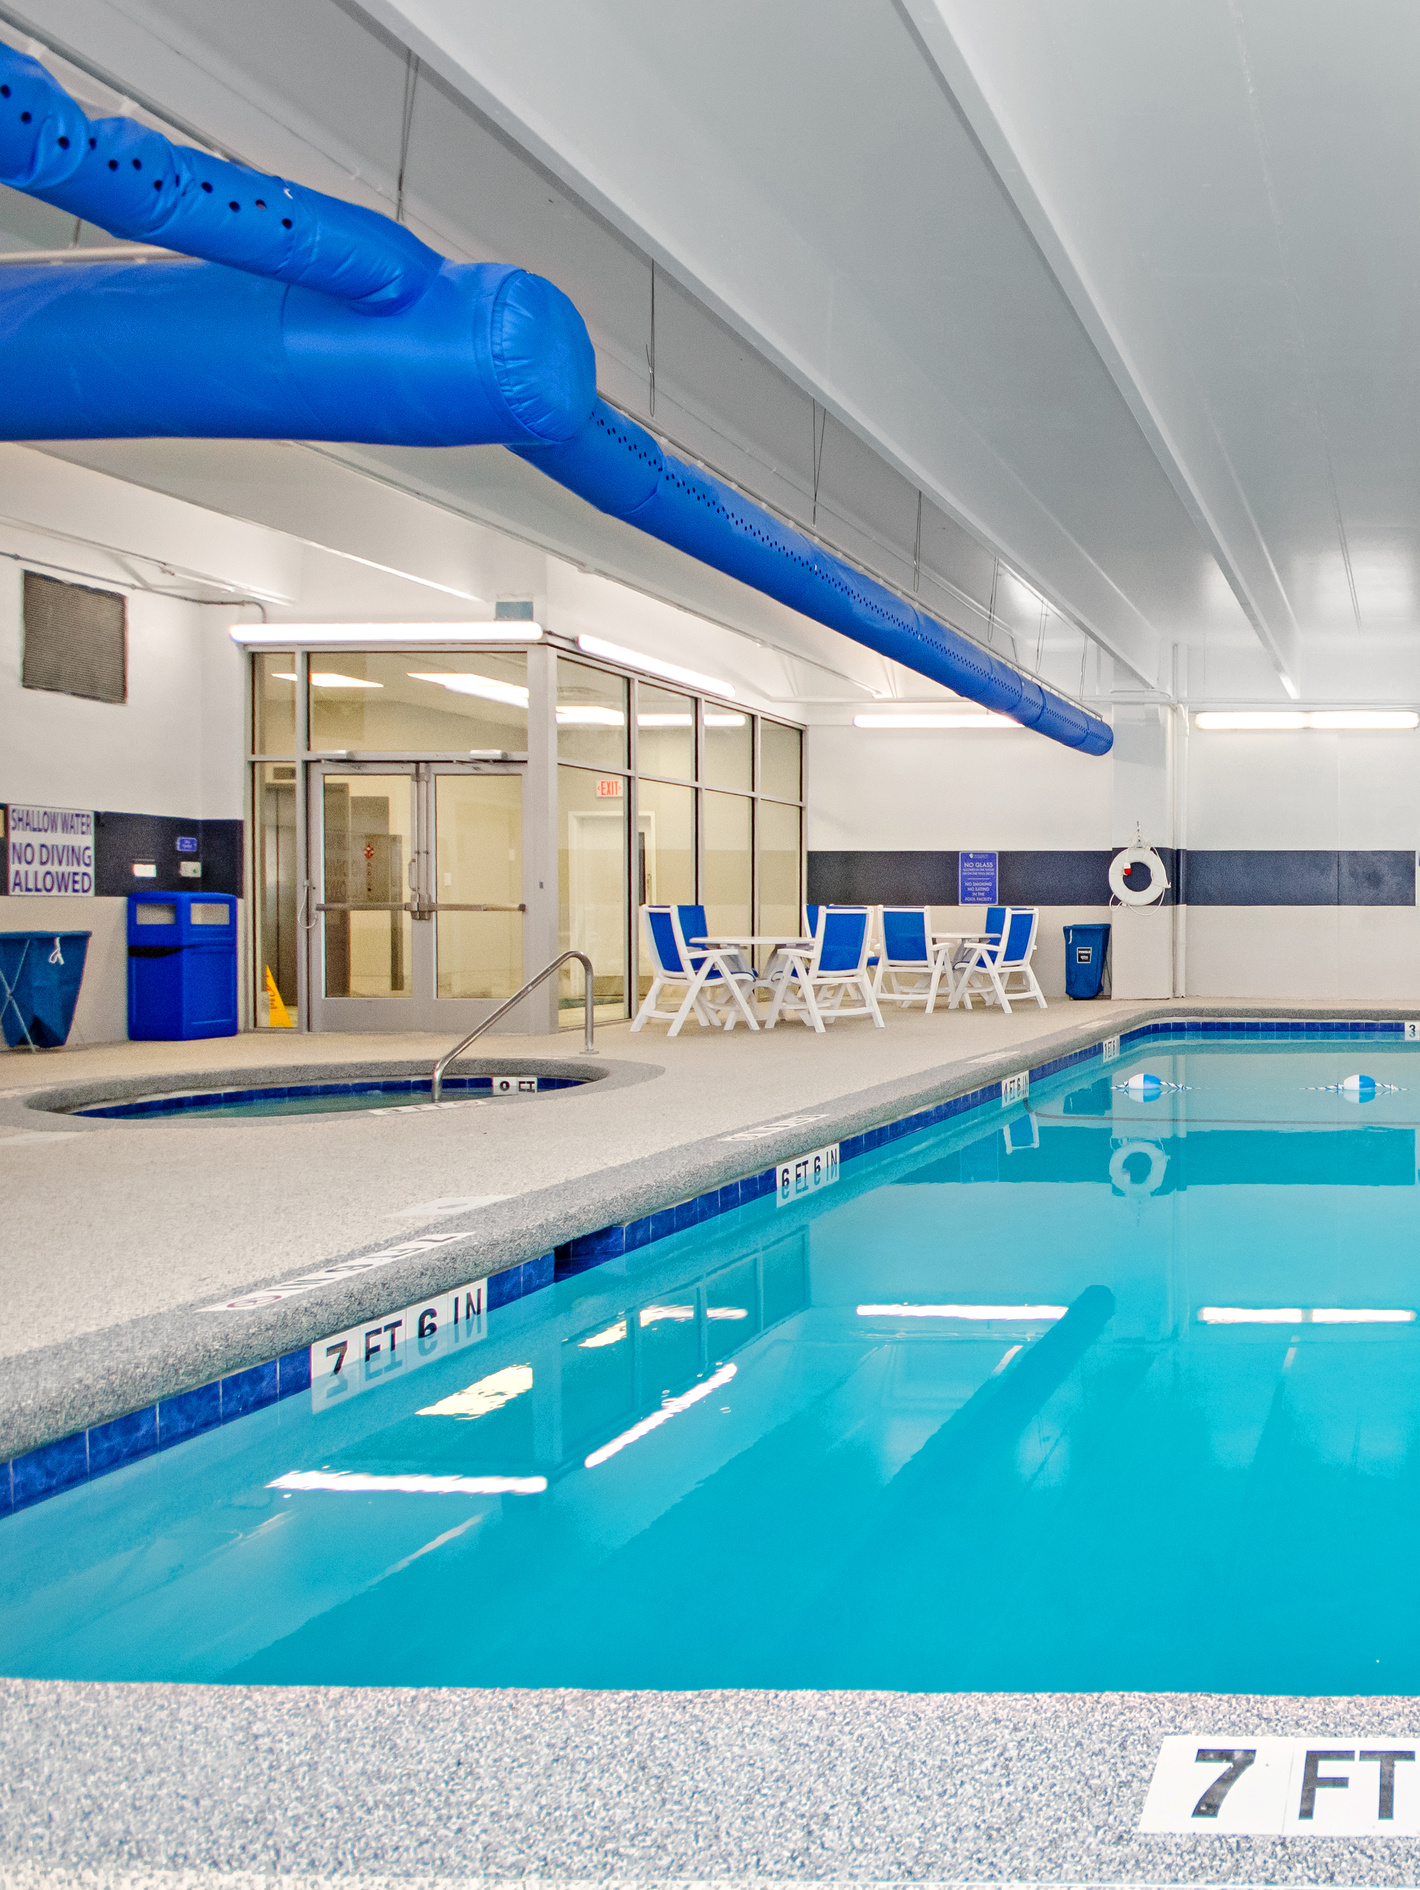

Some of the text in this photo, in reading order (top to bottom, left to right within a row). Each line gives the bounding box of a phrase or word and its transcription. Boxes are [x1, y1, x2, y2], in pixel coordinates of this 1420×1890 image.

[600, 780, 618, 795] EXIT
[11, 808, 92, 836] SHALLOW WATER
[11, 842, 92, 867] NO DIVING
[11, 870, 92, 894] ALLOWED
[326, 1288, 482, 1377] 7 FT 6 IN
[1190, 1748, 1257, 1819] 7
[1297, 1749, 1416, 1819] FT
